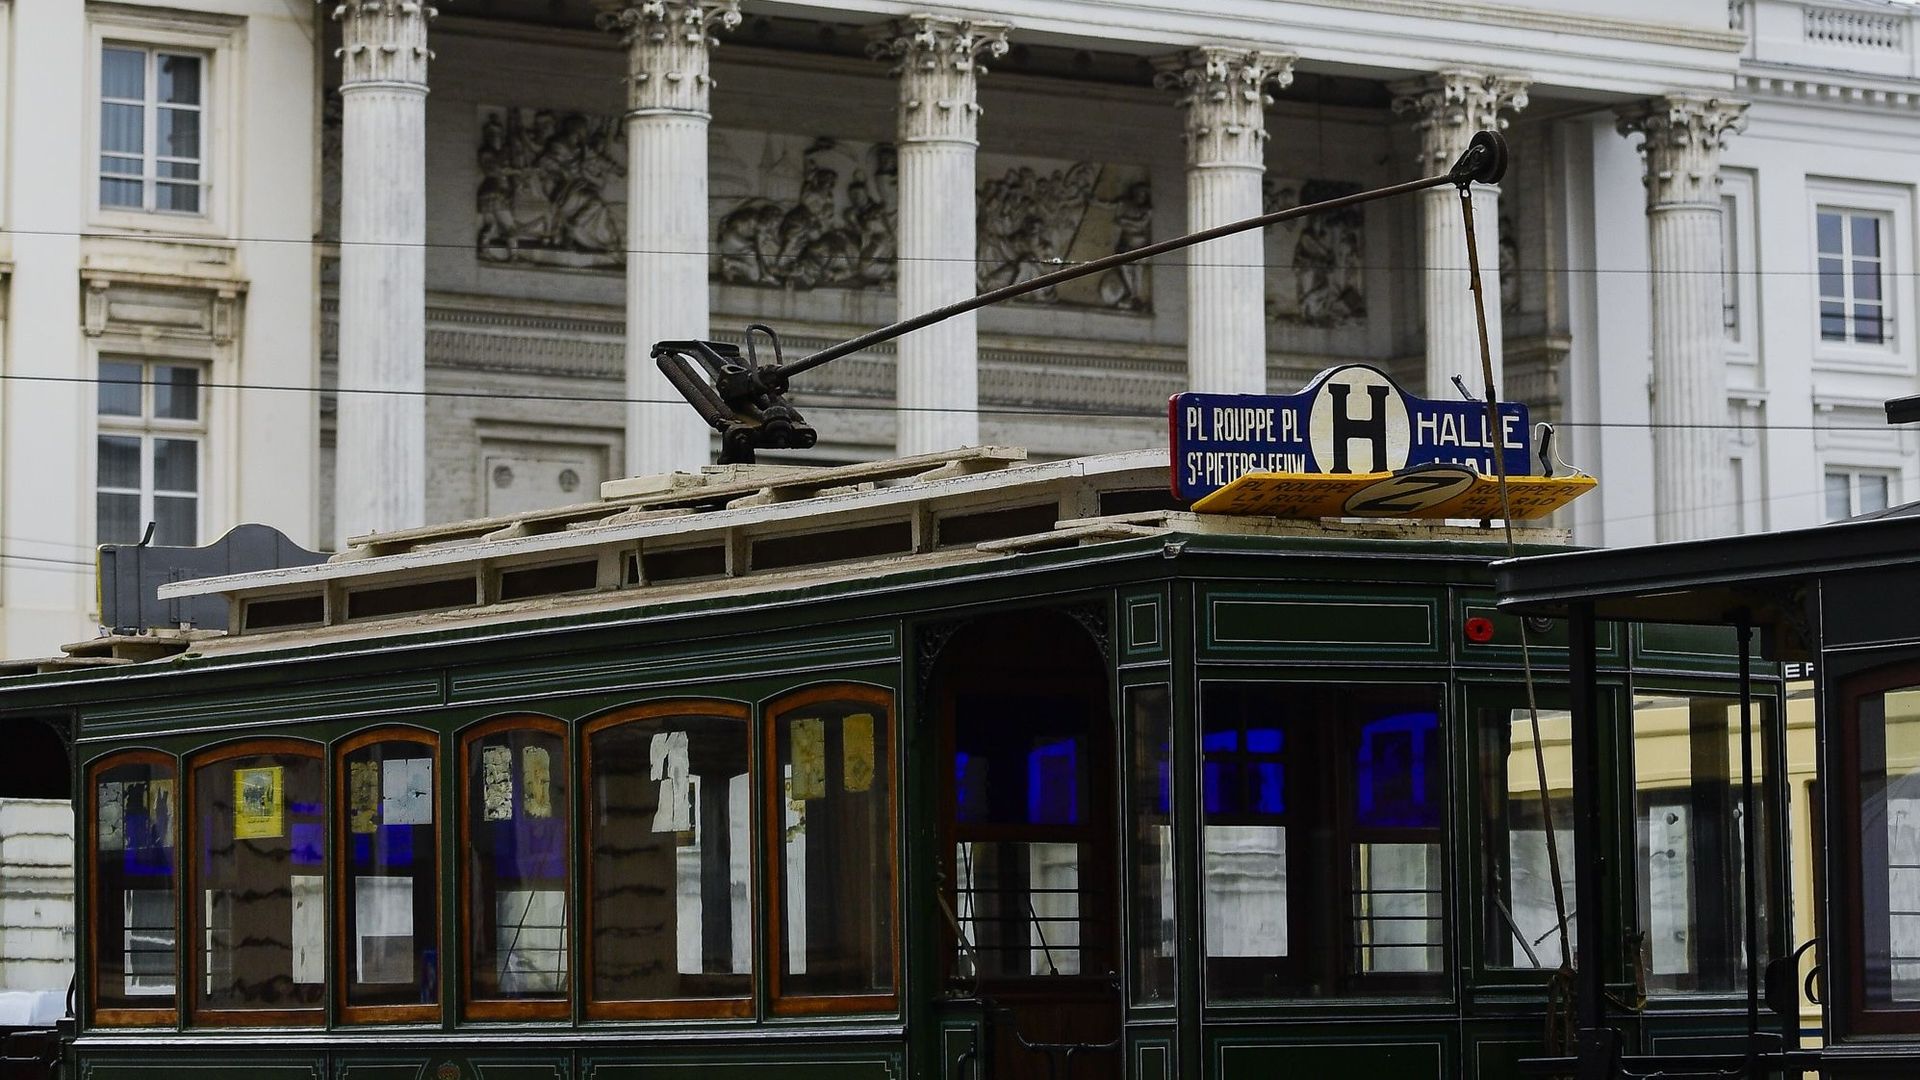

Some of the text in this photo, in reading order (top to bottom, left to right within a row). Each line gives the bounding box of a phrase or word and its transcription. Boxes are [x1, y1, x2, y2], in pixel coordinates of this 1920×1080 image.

[1186, 406, 1303, 442] PL ROUPPE PL
[1328, 384, 1389, 473] H
[1417, 412, 1523, 449] HALLE
[1269, 481, 1359, 493] ROUPPE
